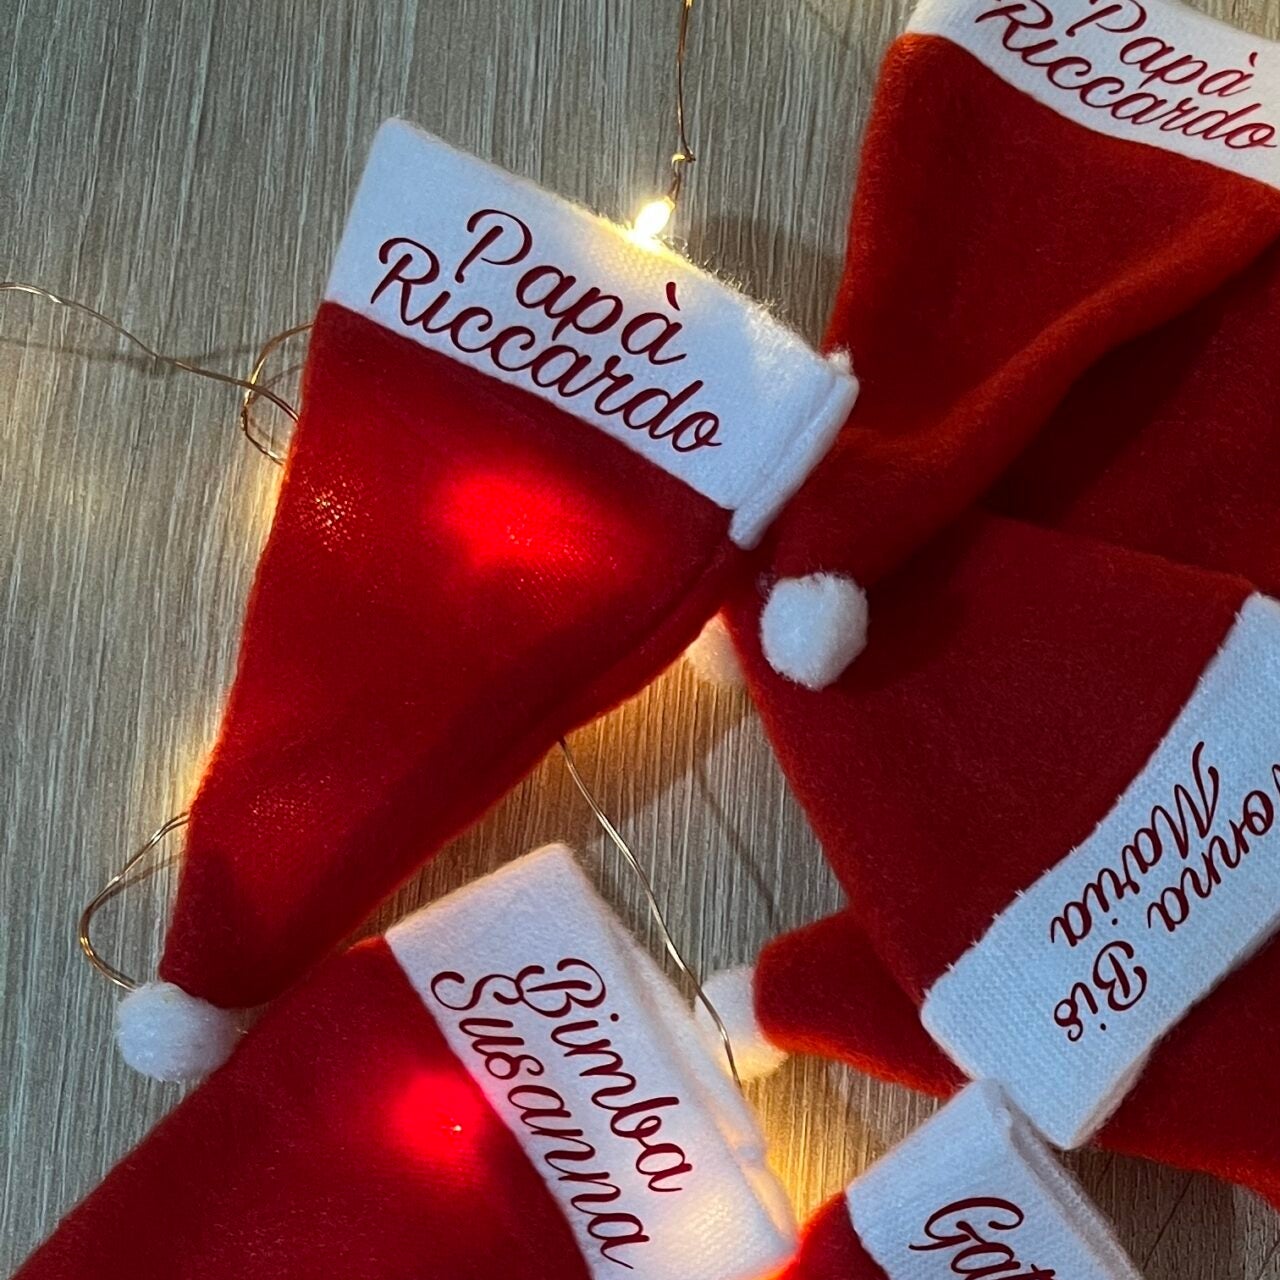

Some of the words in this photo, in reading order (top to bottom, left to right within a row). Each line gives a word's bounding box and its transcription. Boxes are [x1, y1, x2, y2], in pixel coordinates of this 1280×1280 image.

[975, 0, 1278, 150] Riccardo
[370, 237, 723, 453] Riccardo
[453, 208, 687, 367] Papà
[1049, 741, 1220, 948] Maria
[515, 957, 693, 1193] Bimba
[1053, 940, 1148, 1042] Bis
[430, 970, 650, 1270] Susanna
